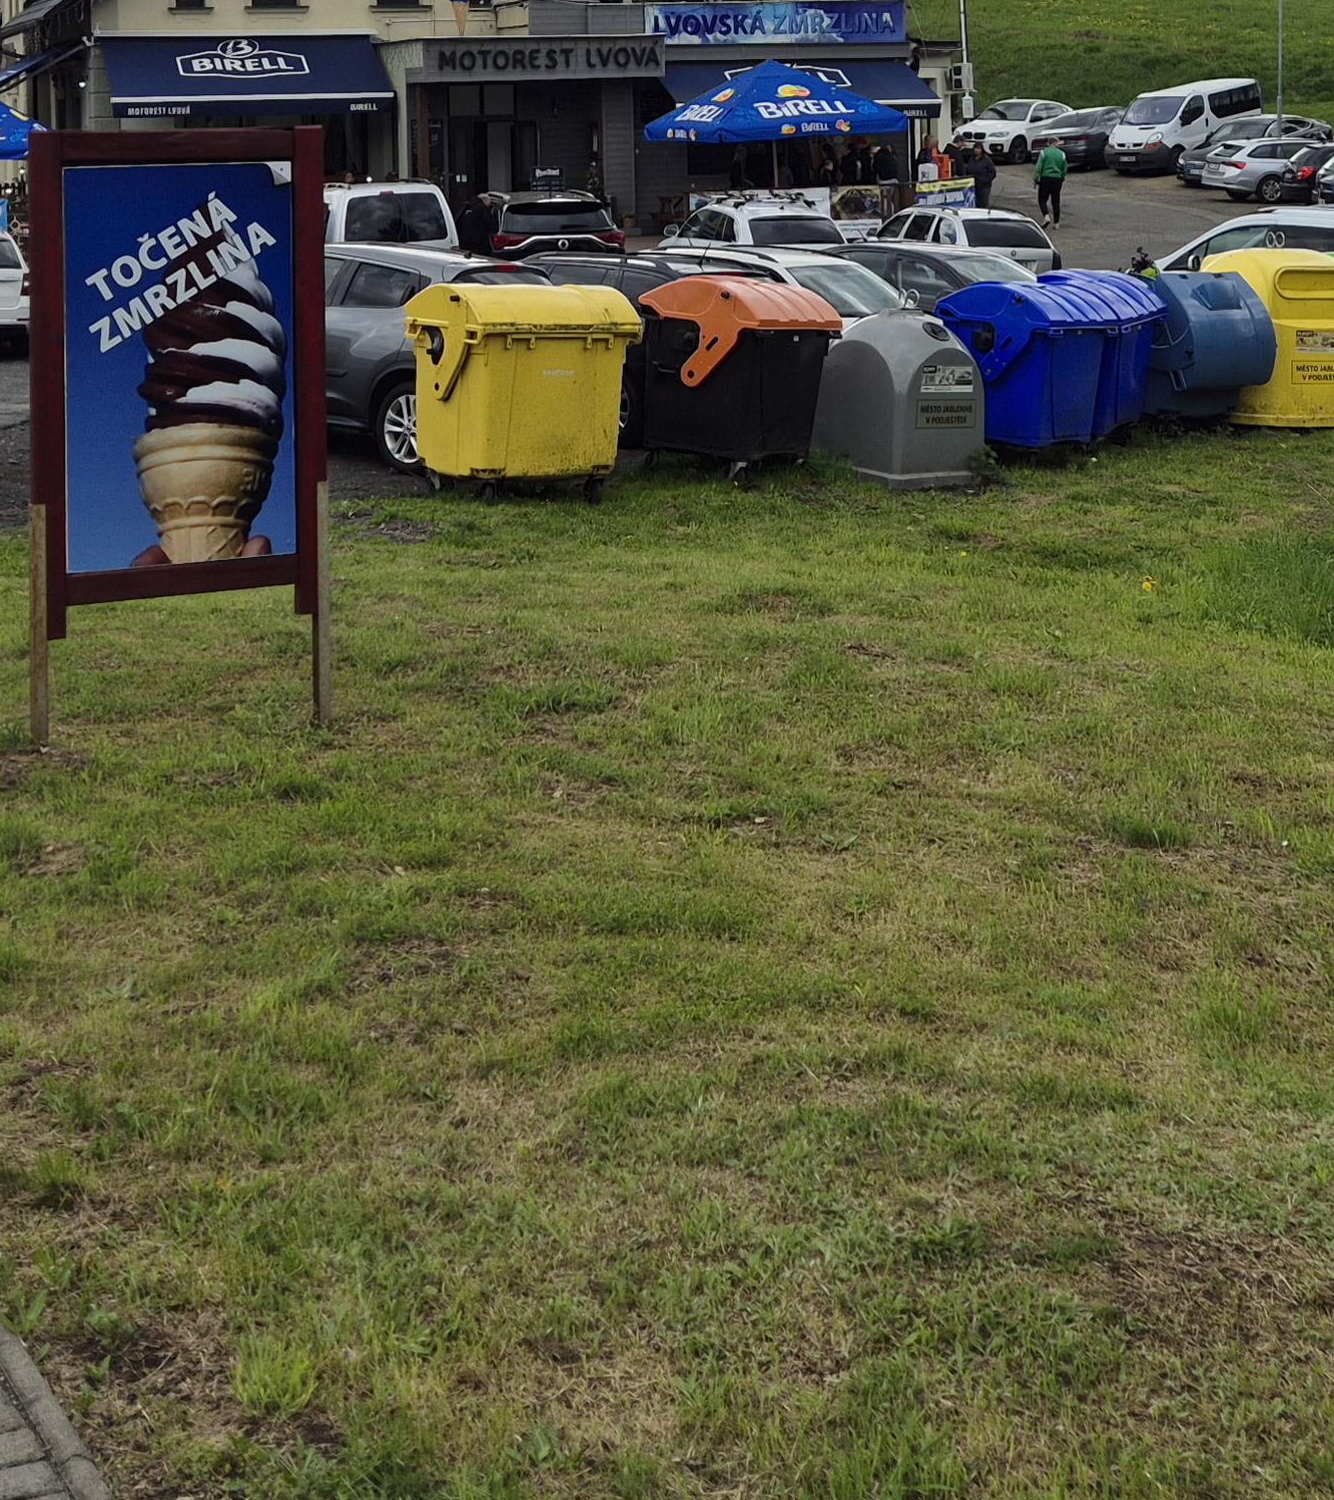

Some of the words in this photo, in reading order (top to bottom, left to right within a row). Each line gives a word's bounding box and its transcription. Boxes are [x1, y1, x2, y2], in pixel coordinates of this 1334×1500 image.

[653, 10, 766, 36] LVOVSKÁ
[772, 11, 896, 35] ZMRZLINA
[191, 56, 295, 72] BIRELL
[438, 48, 574, 71] MOTOREST
[586, 40, 660, 68] LVOVÁ
[85, 191, 238, 301] TOČENÁ
[88, 221, 277, 353] ZMRZLINA
